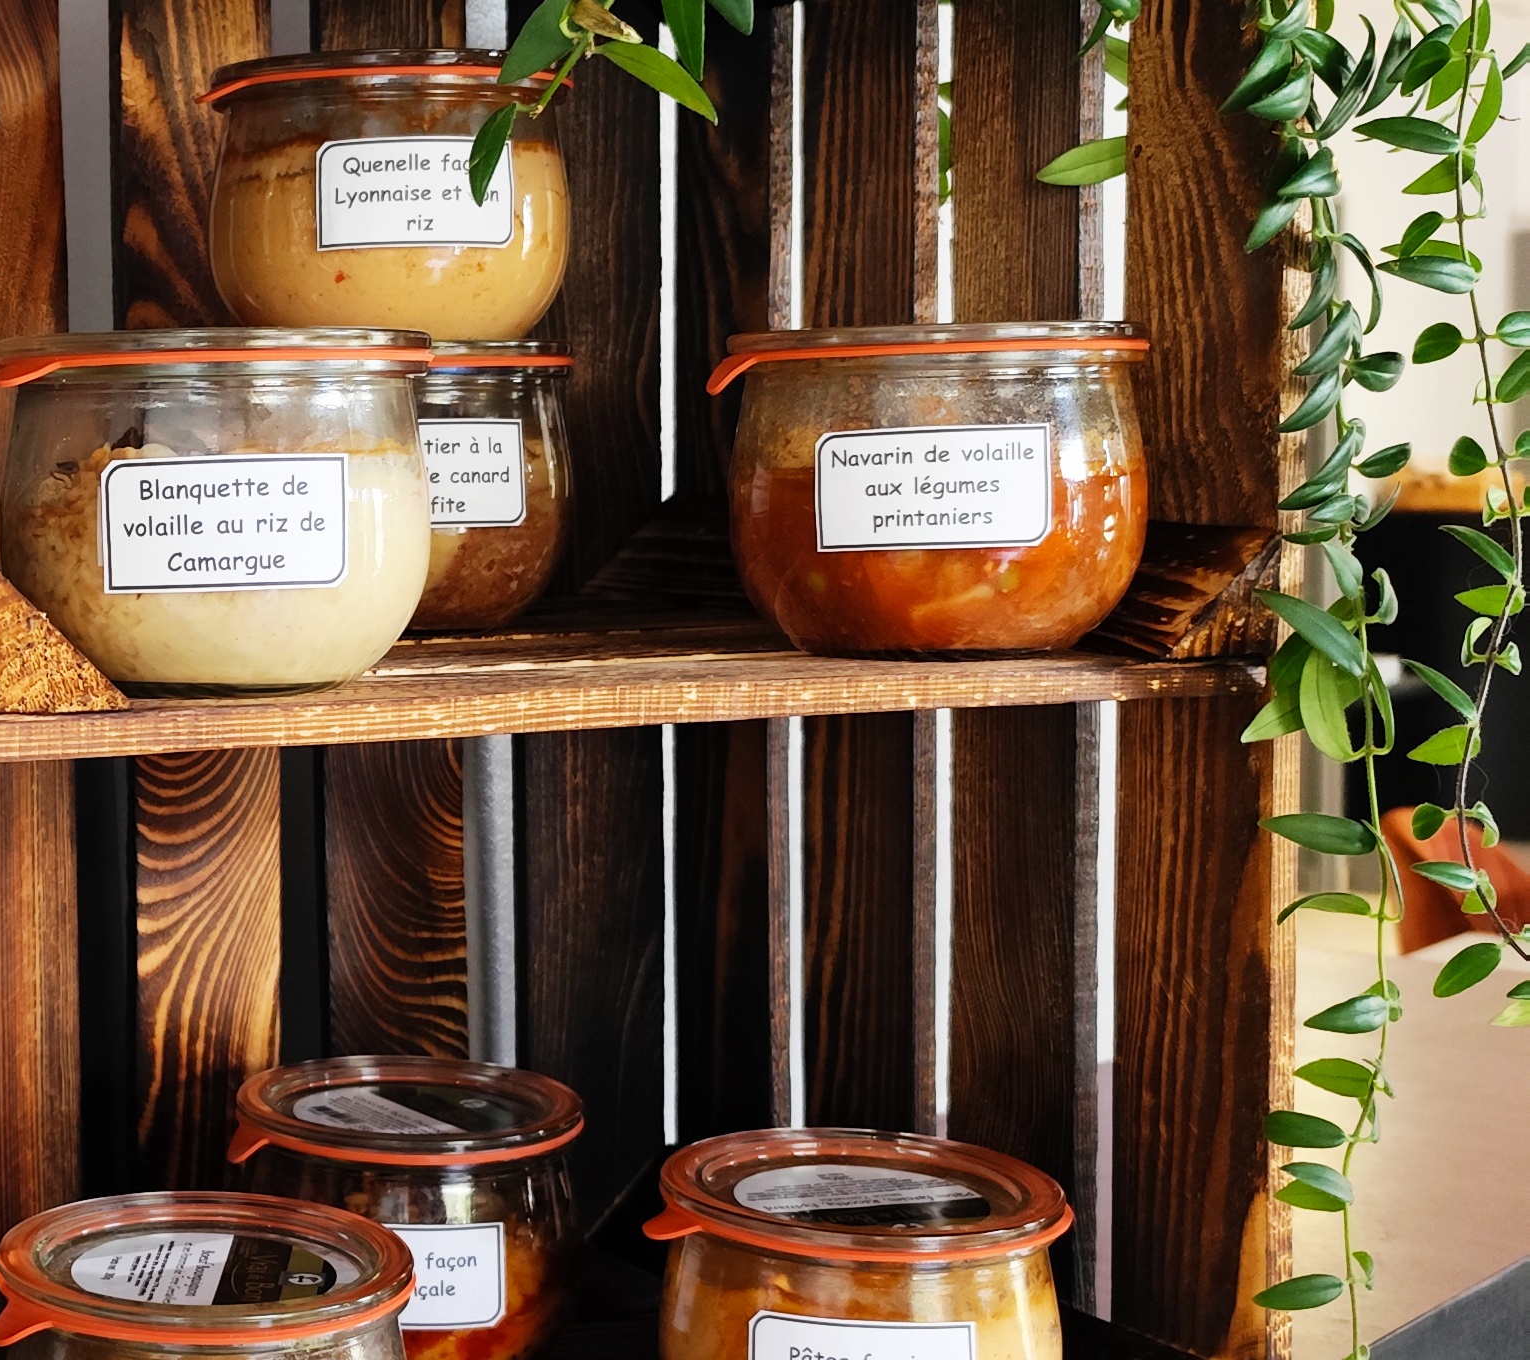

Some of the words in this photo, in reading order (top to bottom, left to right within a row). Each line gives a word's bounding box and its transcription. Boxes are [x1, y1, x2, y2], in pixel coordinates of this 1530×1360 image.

[342, 153, 431, 178] Quenelle
[440, 152, 470, 175] faç
[334, 184, 432, 209] Lyonnaise
[441, 185, 463, 201] et
[406, 214, 434, 231] riz
[469, 436, 480, 454] à
[488, 436, 503, 454] la
[831, 446, 913, 469] Navarin
[924, 444, 951, 463] de
[961, 441, 1035, 462] volaille
[449, 465, 510, 484] canard
[139, 477, 270, 505] Blanquette
[282, 474, 309, 496] de
[865, 482, 903, 497] aux
[914, 475, 1000, 500] légumes
[122, 513, 204, 538] volaille
[216, 518, 244, 535] au
[256, 512, 288, 534] riz
[300, 510, 326, 532] de
[872, 507, 993, 534] printaniers
[167, 551, 286, 576] Camargue
[424, 1251, 477, 1272] façon
